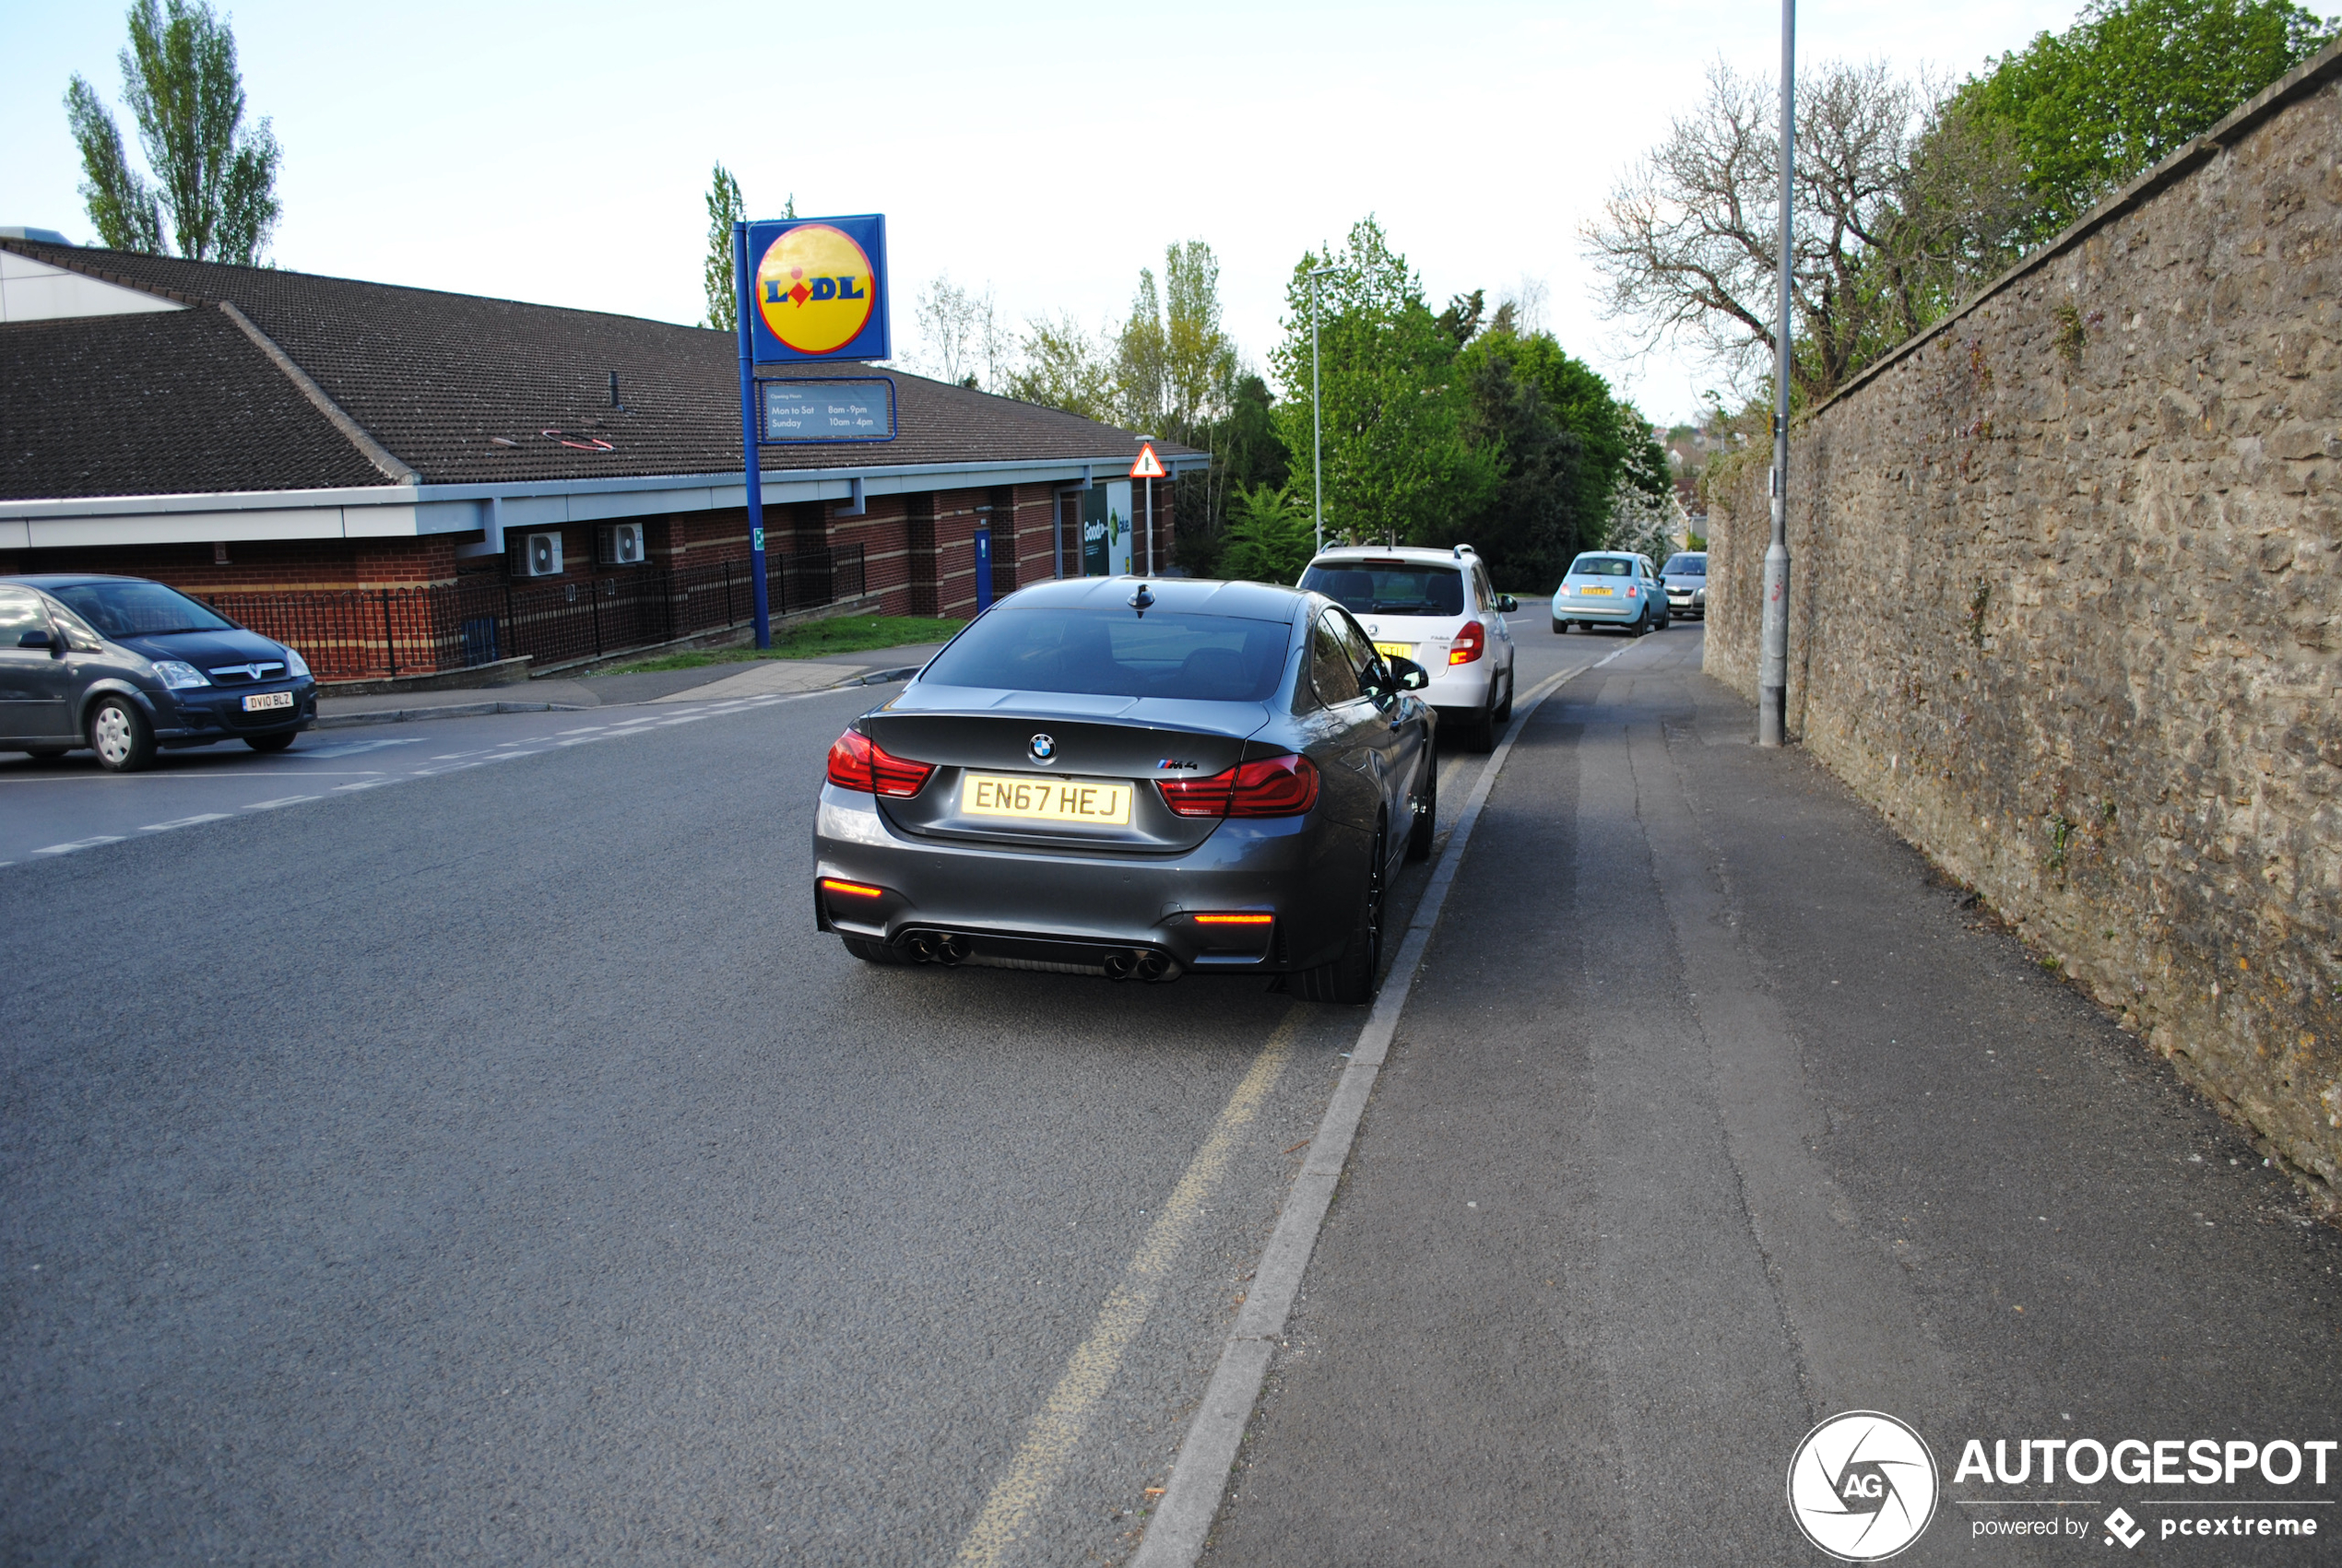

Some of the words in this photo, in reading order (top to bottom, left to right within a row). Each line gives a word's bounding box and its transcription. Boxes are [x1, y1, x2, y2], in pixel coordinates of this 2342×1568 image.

[772, 407, 789, 415] Mon
[791, 407, 799, 415] to
[801, 406, 814, 415] Sat
[828, 406, 846, 414] 8am
[850, 406, 867, 416] 9pm
[772, 419, 802, 429] Sunday
[829, 418, 850, 427] 10am
[857, 418, 874, 428] 4pm
[1084, 519, 1102, 542] Good
[273, 693, 290, 706] BLZ
[975, 781, 1051, 811] EN67
[1059, 787, 1118, 817] HEJ
